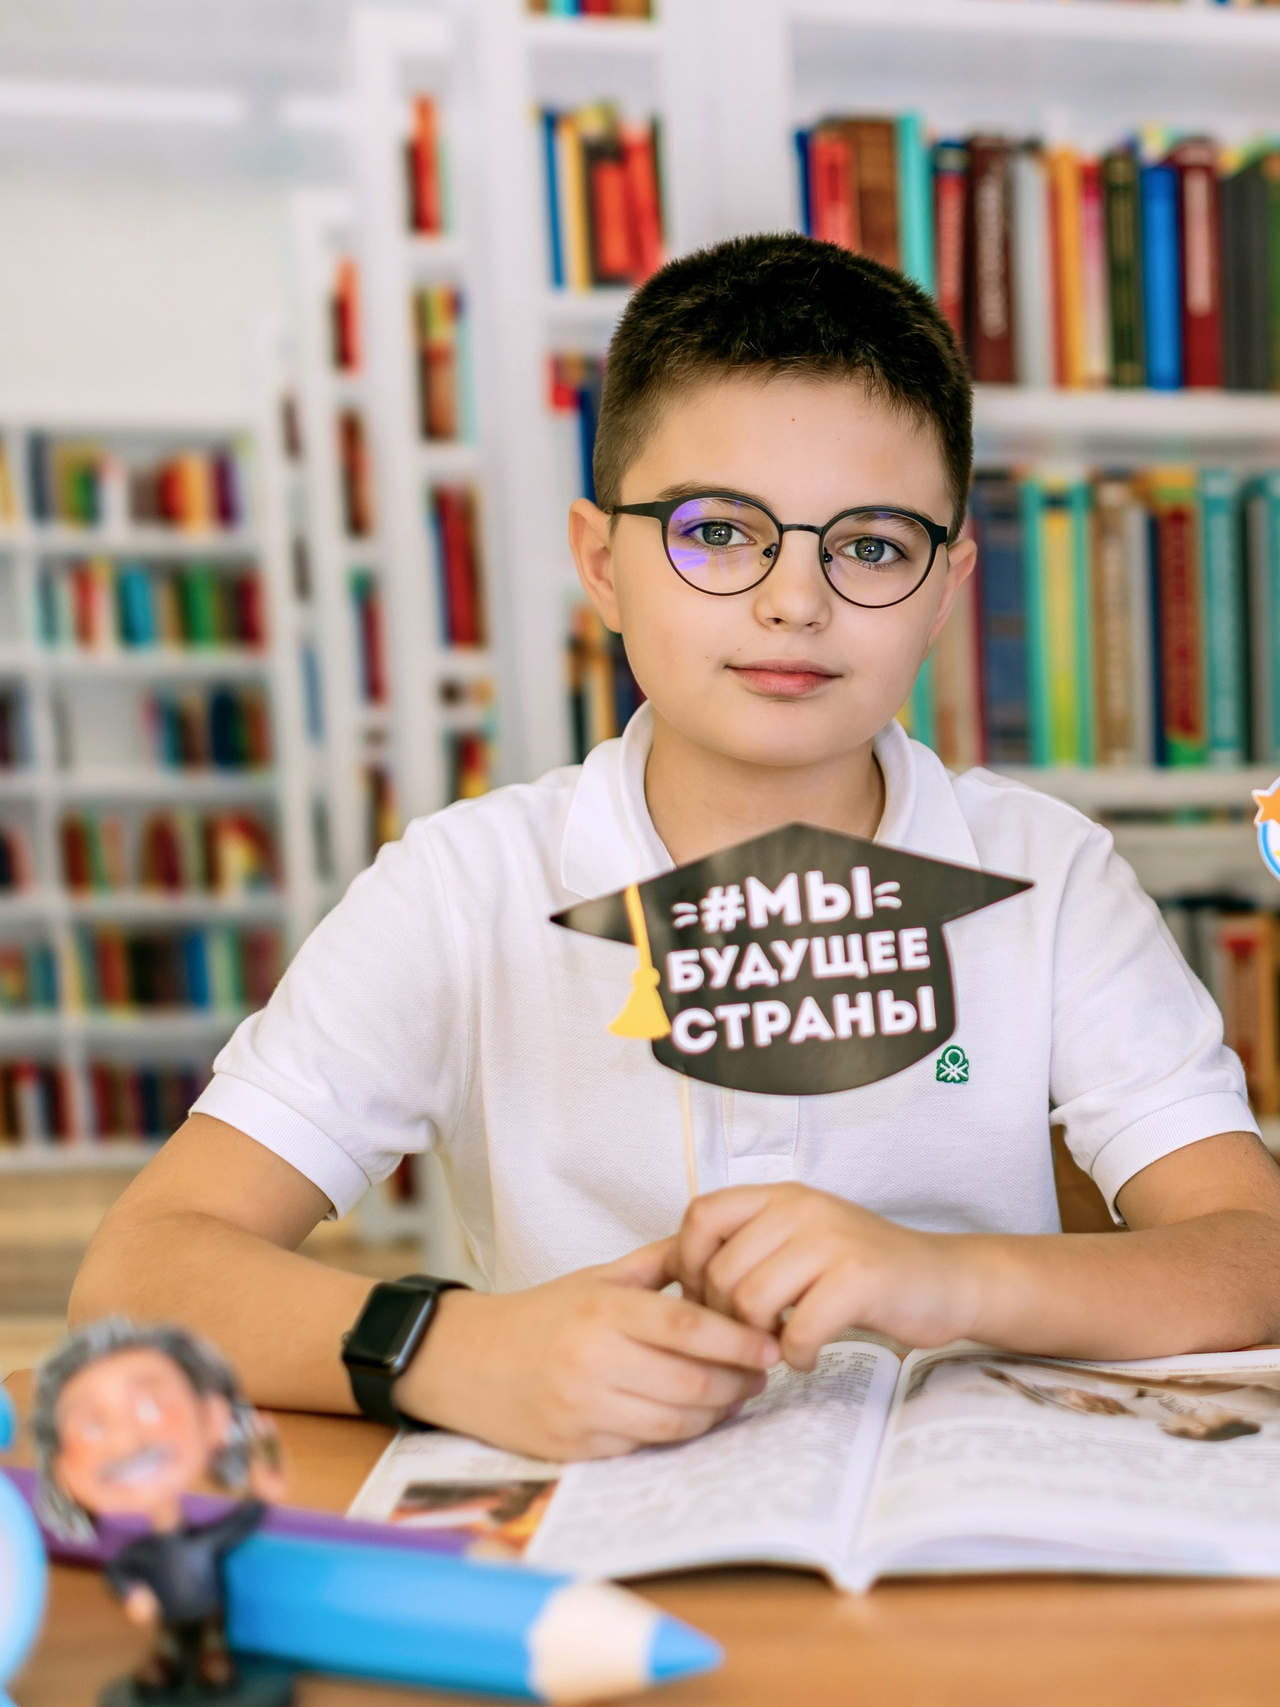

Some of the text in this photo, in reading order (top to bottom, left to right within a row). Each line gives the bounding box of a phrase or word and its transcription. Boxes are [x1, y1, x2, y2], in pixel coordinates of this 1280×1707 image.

[700, 867, 875, 932] #МЫ
[668, 927, 931, 992] БУДУЩЕЕ
[671, 986, 936, 1054] СТРАНЫ
